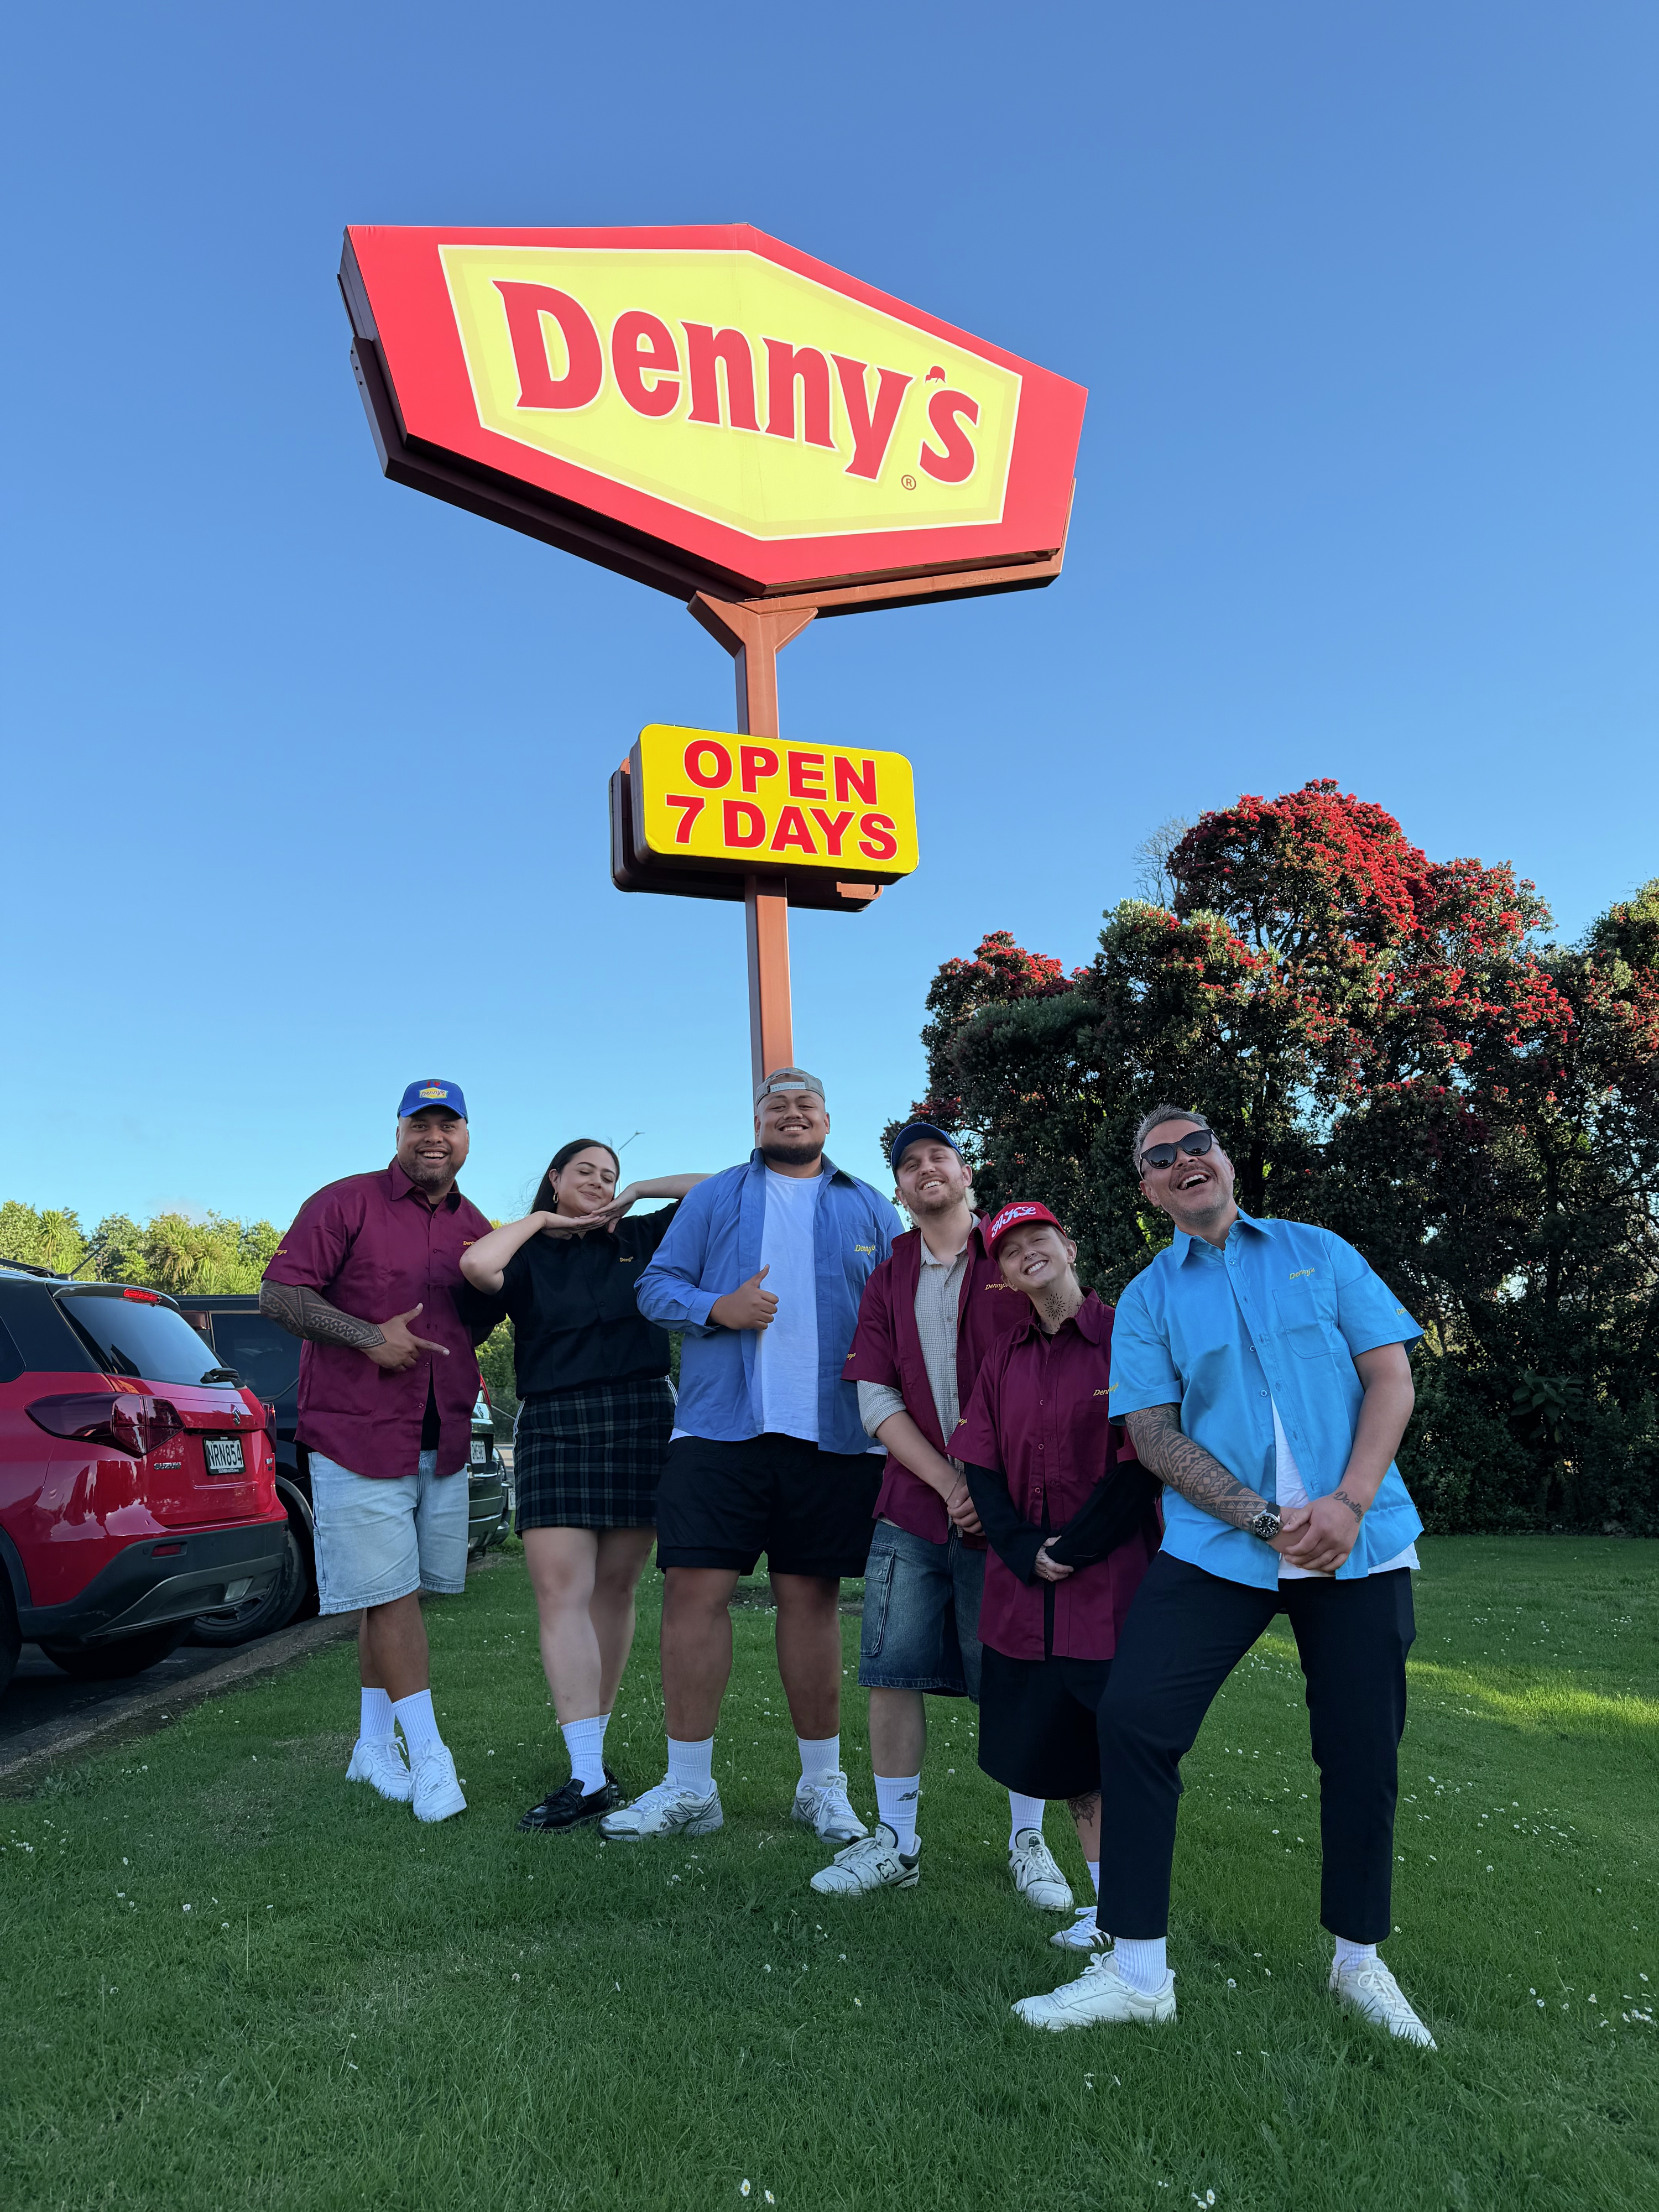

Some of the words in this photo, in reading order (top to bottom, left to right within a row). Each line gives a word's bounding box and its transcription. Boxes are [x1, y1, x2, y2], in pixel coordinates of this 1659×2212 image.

[492, 280, 979, 483] Denny's
[684, 740, 877, 805] OPEN
[666, 795, 705, 843] 7
[723, 800, 898, 859] DAYS
[207, 1444, 242, 1467] NRN854
